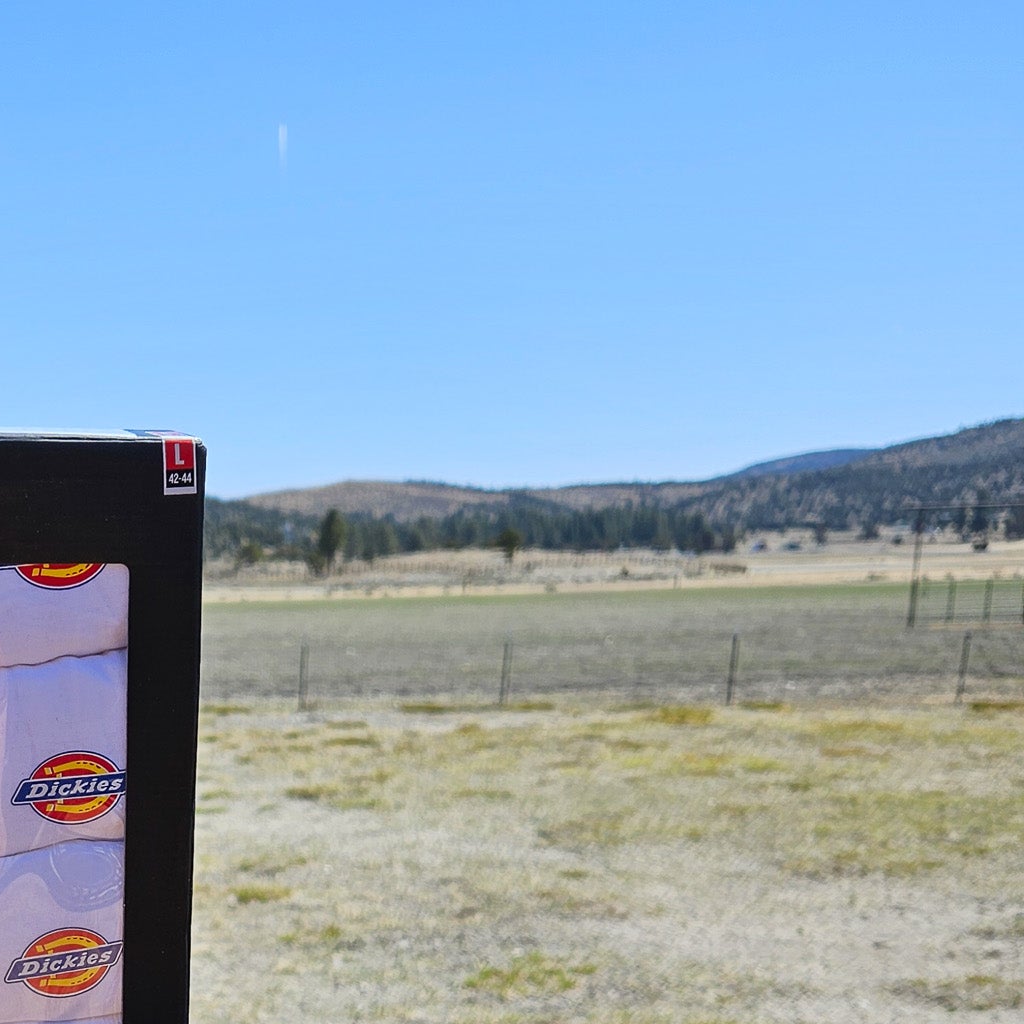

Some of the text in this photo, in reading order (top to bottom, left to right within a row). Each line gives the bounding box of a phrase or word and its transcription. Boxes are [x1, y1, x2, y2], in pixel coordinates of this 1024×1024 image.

[174, 443, 185, 465] L
[168, 472, 192, 484] 42-44
[26, 776, 123, 799] Dickies
[18, 949, 113, 977] Dickies
